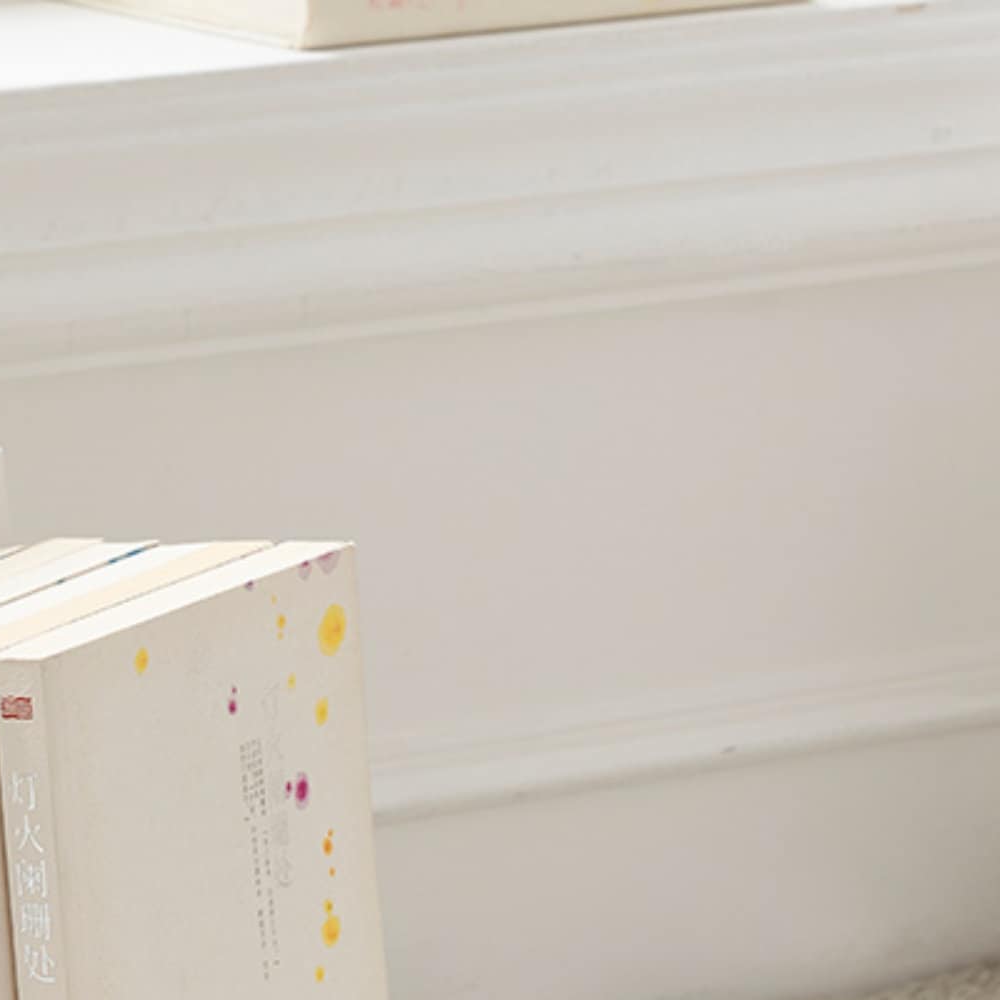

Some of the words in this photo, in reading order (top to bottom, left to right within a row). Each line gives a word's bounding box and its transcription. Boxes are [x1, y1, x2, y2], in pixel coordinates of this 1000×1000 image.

[10, 770, 56, 984] 灯火阑珊处
